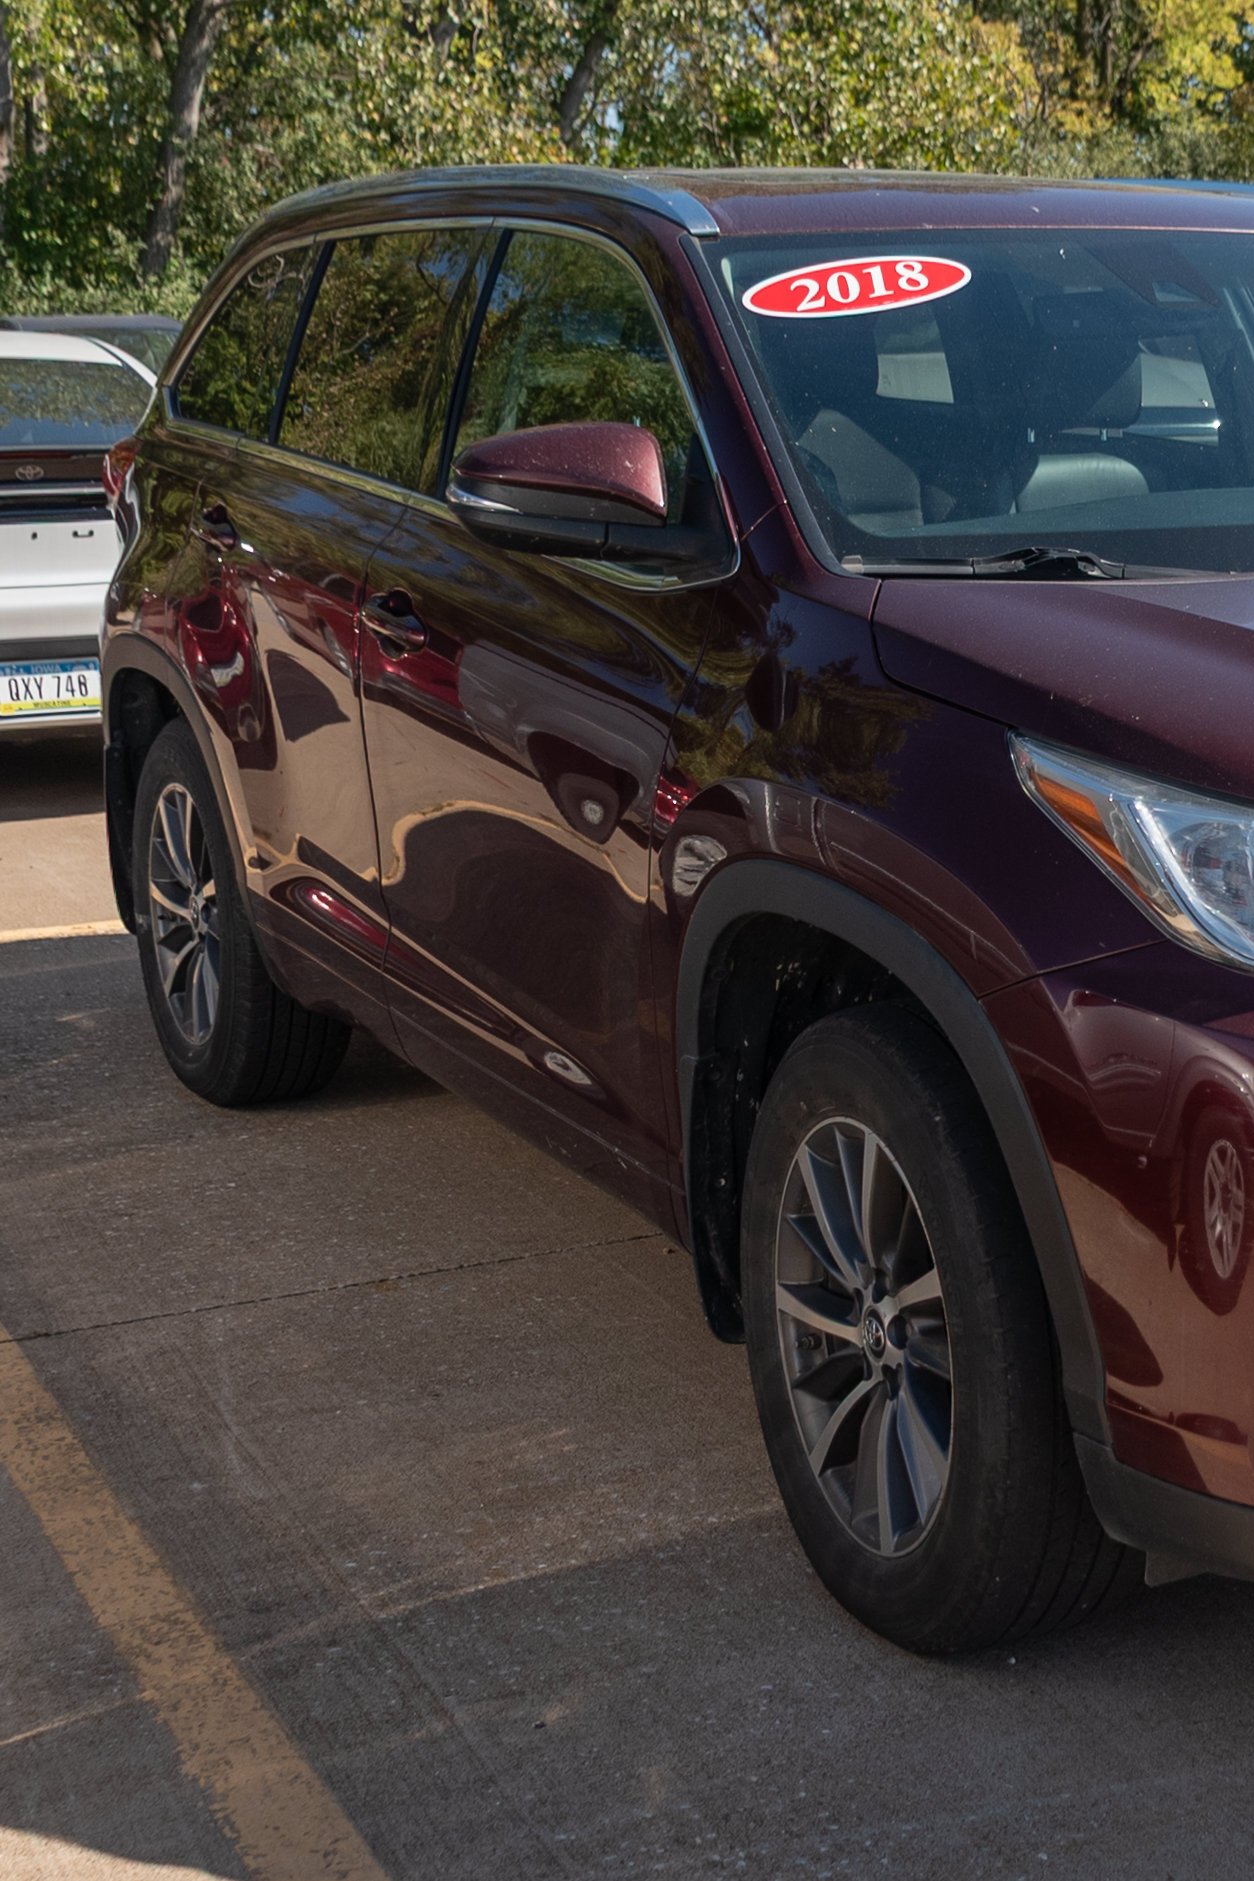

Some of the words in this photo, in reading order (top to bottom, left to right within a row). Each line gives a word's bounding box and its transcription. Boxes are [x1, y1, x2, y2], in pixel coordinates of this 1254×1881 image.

[790, 260, 929, 311] 2018
[31, 664, 61, 673] IOWA
[8, 677, 43, 701] QXY
